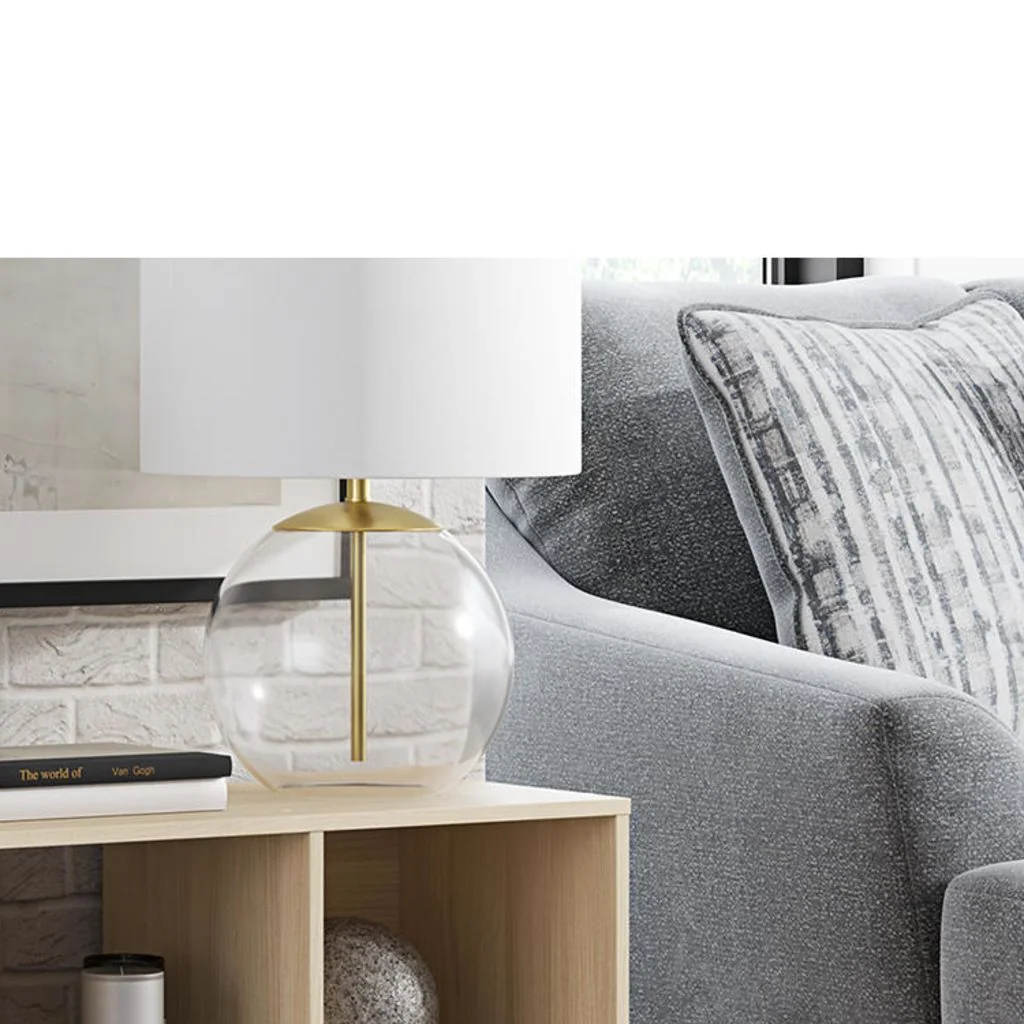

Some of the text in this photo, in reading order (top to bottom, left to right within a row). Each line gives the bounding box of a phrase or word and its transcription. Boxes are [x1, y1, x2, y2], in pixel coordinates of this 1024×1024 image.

[19, 766, 83, 781] The world of
[112, 767, 129, 777] Van
